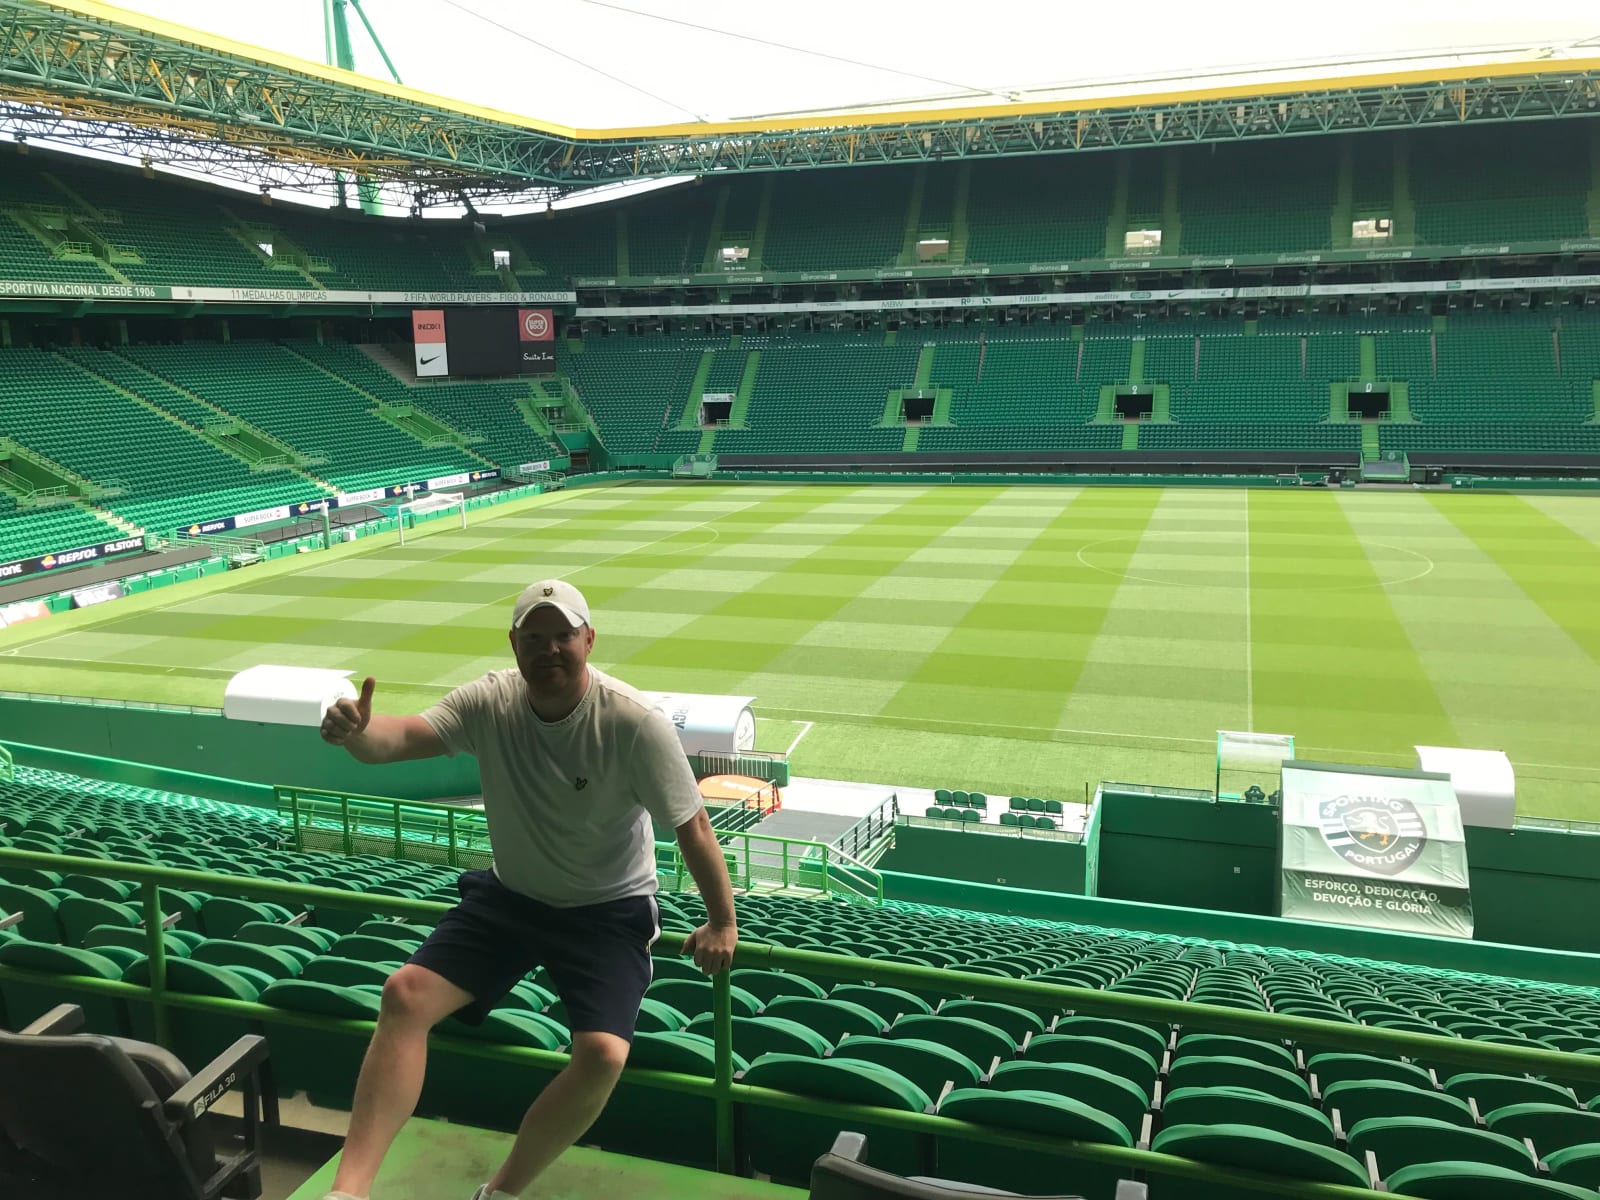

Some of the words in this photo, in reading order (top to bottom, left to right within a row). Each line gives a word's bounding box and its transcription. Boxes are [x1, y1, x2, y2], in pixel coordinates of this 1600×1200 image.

[52, 285, 100, 296] NACIONAL
[102, 286, 132, 297] DESDE
[134, 287, 156, 297] 1906
[231, 290, 240, 299] 11
[242, 290, 285, 300] MEDALHAS
[404, 293, 409, 301] 2
[411, 293, 427, 301] FIFA
[430, 293, 456, 301] WORLD
[458, 293, 492, 302] PLAYERS
[500, 292, 521, 301] FIGO
[529, 292, 568, 301] RONALDO
[58, 548, 98, 564] REPSOL
[104, 537, 143, 553] FILSTONE
[1322, 795, 1404, 817] SPORTING
[1344, 842, 1420, 865] PORTUGAL
[1304, 878, 1361, 894] ESFORÇO,
[1364, 885, 1441, 904] DEDICAÇÃO,
[1313, 892, 1372, 907] DEVOÇÃO
[1375, 899, 1383, 909] E
[1385, 900, 1433, 915] GLÓRIA
[204, 1083, 224, 1106] FILA
[224, 1072, 236, 1087] 30
